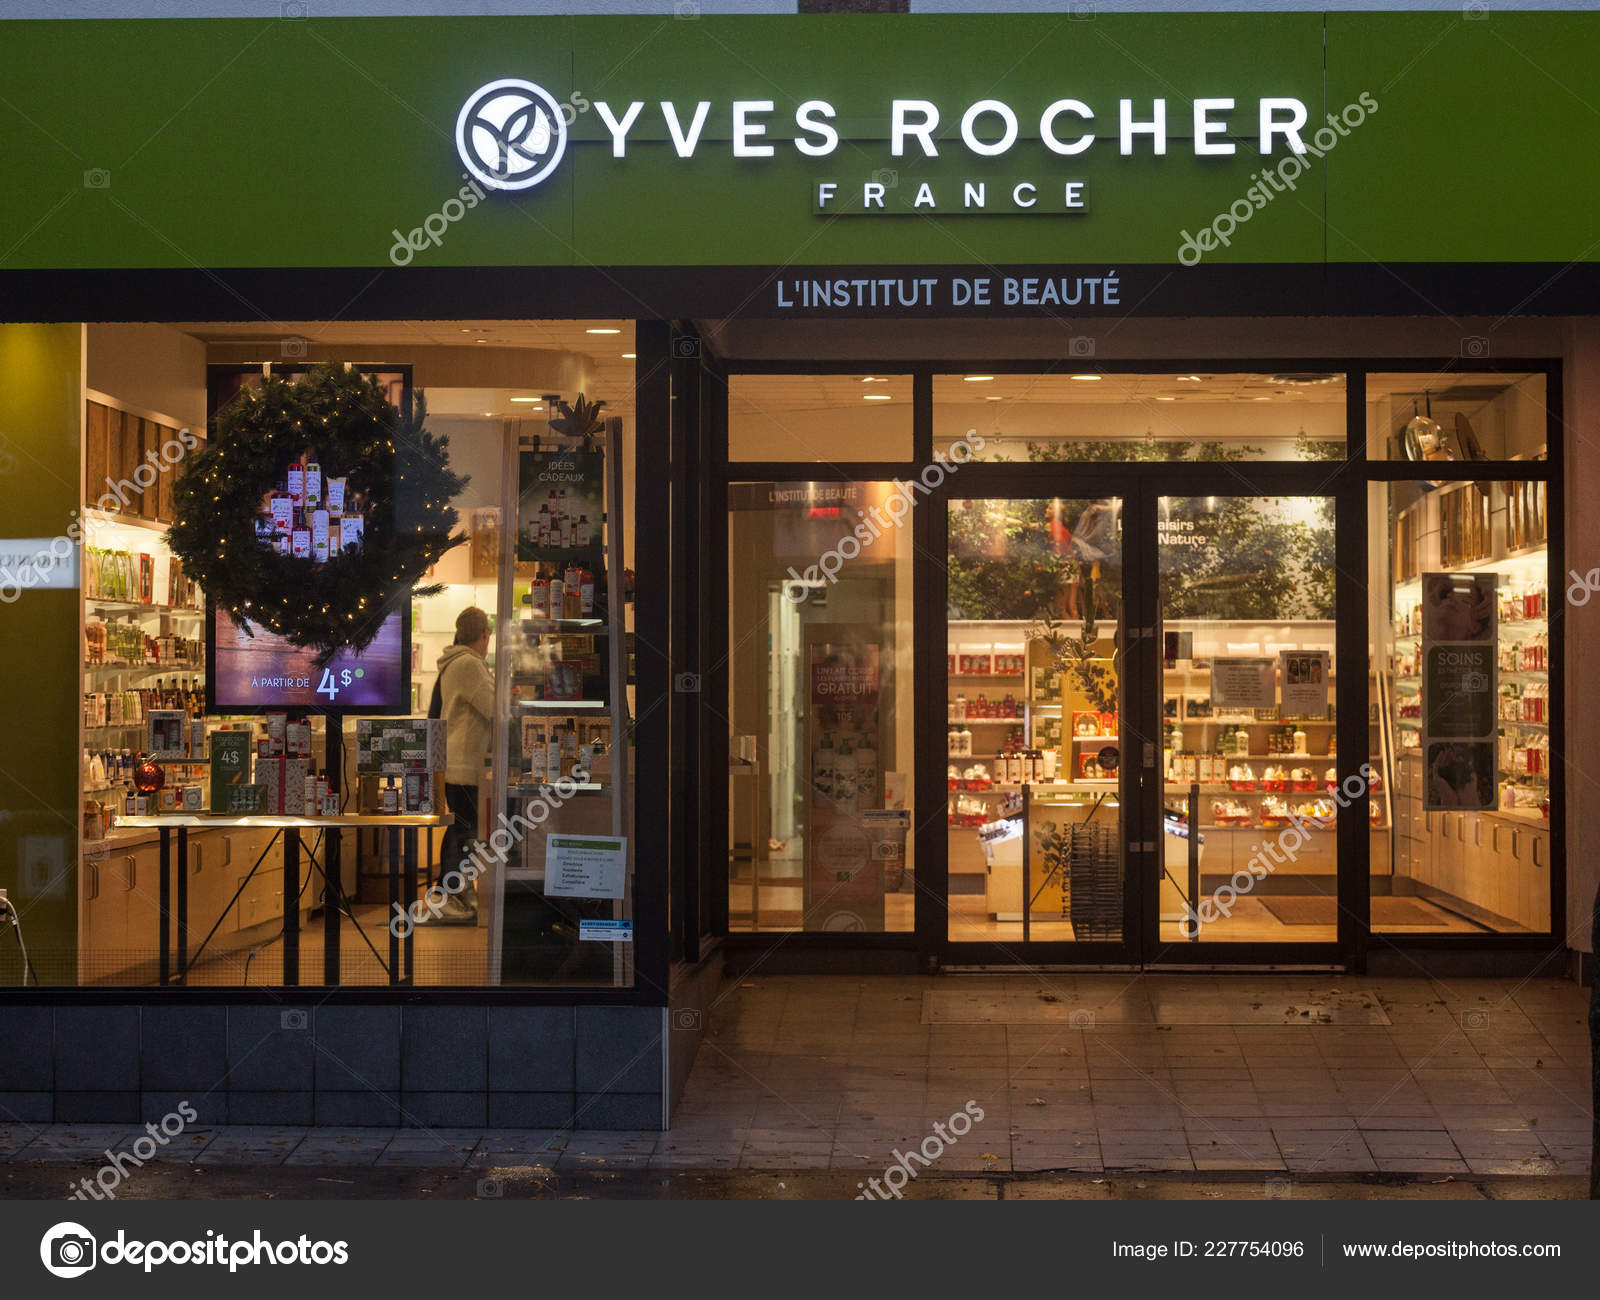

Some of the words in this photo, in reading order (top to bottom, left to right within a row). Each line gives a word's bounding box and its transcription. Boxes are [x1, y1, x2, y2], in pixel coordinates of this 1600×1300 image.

[593, 99, 839, 158] YVES
[891, 97, 1309, 157] ROCHER
[818, 182, 1085, 208] FRANCE
[777, 278, 938, 307] L'INSTITUT
[952, 278, 991, 306] DE
[1003, 270, 1121, 306] BEAUTÉ
[538, 472, 585, 482] CADEAUX
[1158, 518, 1195, 531] aisirs
[1158, 532, 1207, 545] Nature
[1438, 652, 1484, 666] SOINS
[261, 677, 294, 688] PARTIR
[296, 678, 311, 688] DE
[816, 681, 873, 696] GRATUIT
[220, 750, 239, 765] 4$
